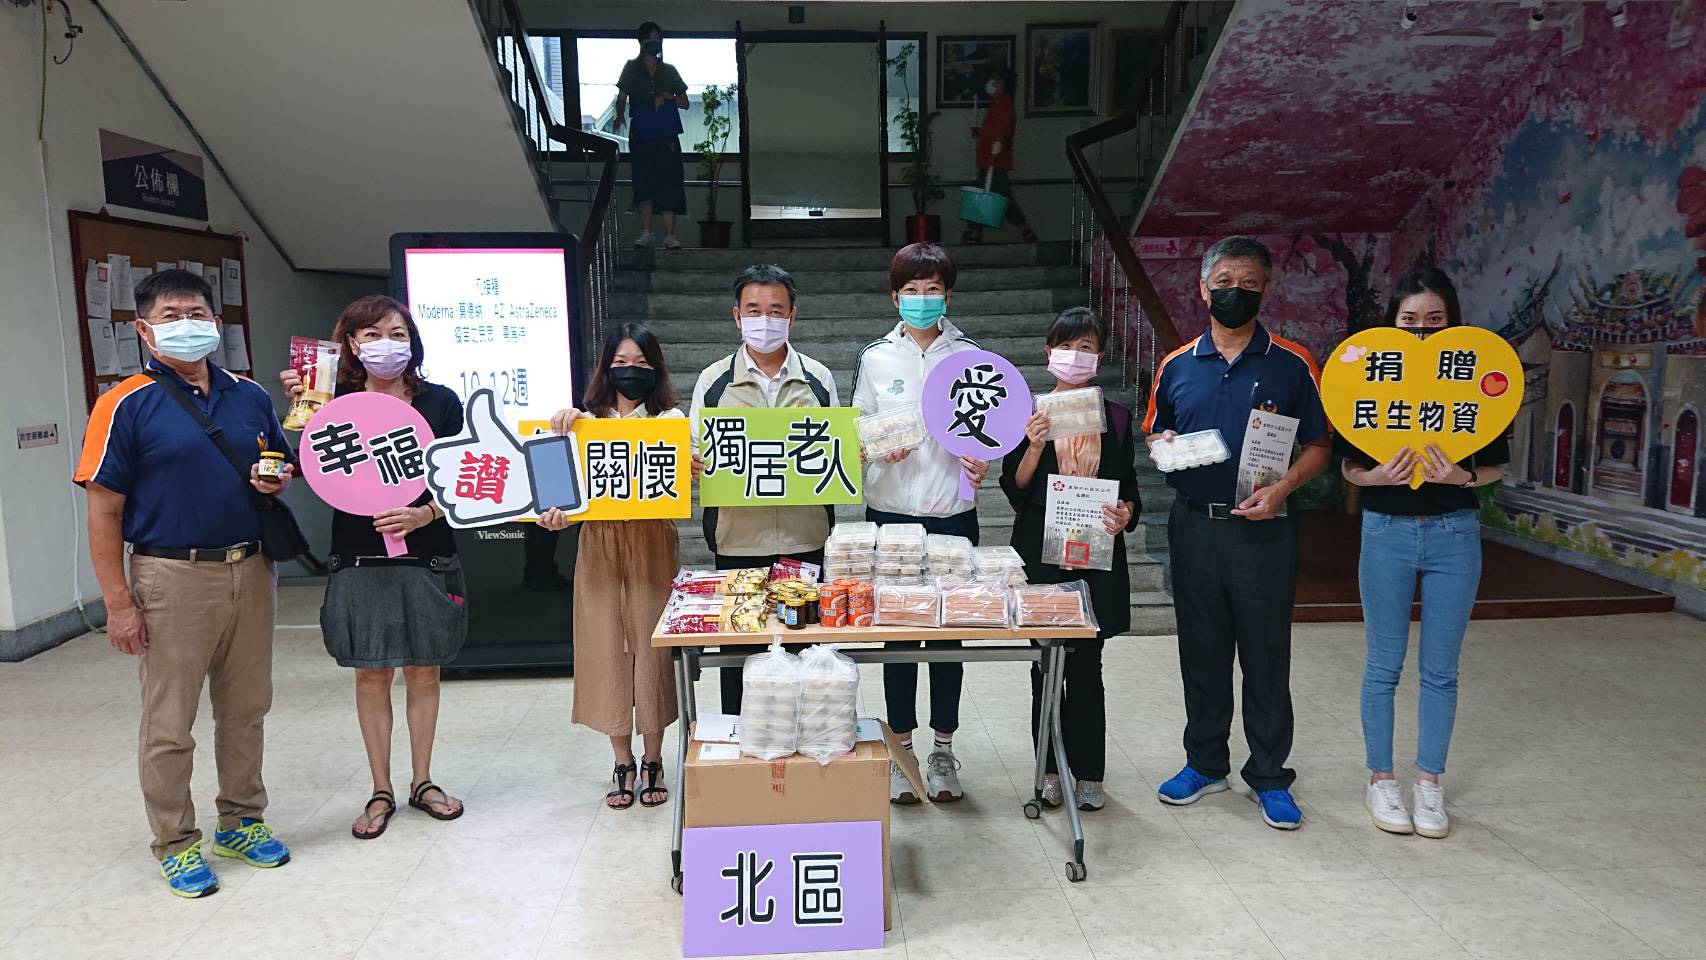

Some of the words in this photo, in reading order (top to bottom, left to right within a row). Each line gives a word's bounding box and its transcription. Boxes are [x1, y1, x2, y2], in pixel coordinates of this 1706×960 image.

[134, 163, 179, 196] 公佈欄
[418, 303, 454, 319] Moderna
[494, 303, 505, 319] AZ
[510, 303, 557, 319] AstraZeneca
[946, 363, 1009, 449] 愛
[1352, 399, 1480, 435] 民生物資
[309, 422, 424, 486] 幸福
[455, 450, 511, 504] 讚
[703, 416, 858, 499] 獨居老人
[476, 529, 526, 540] ViewSonic
[720, 851, 845, 927] 北區
